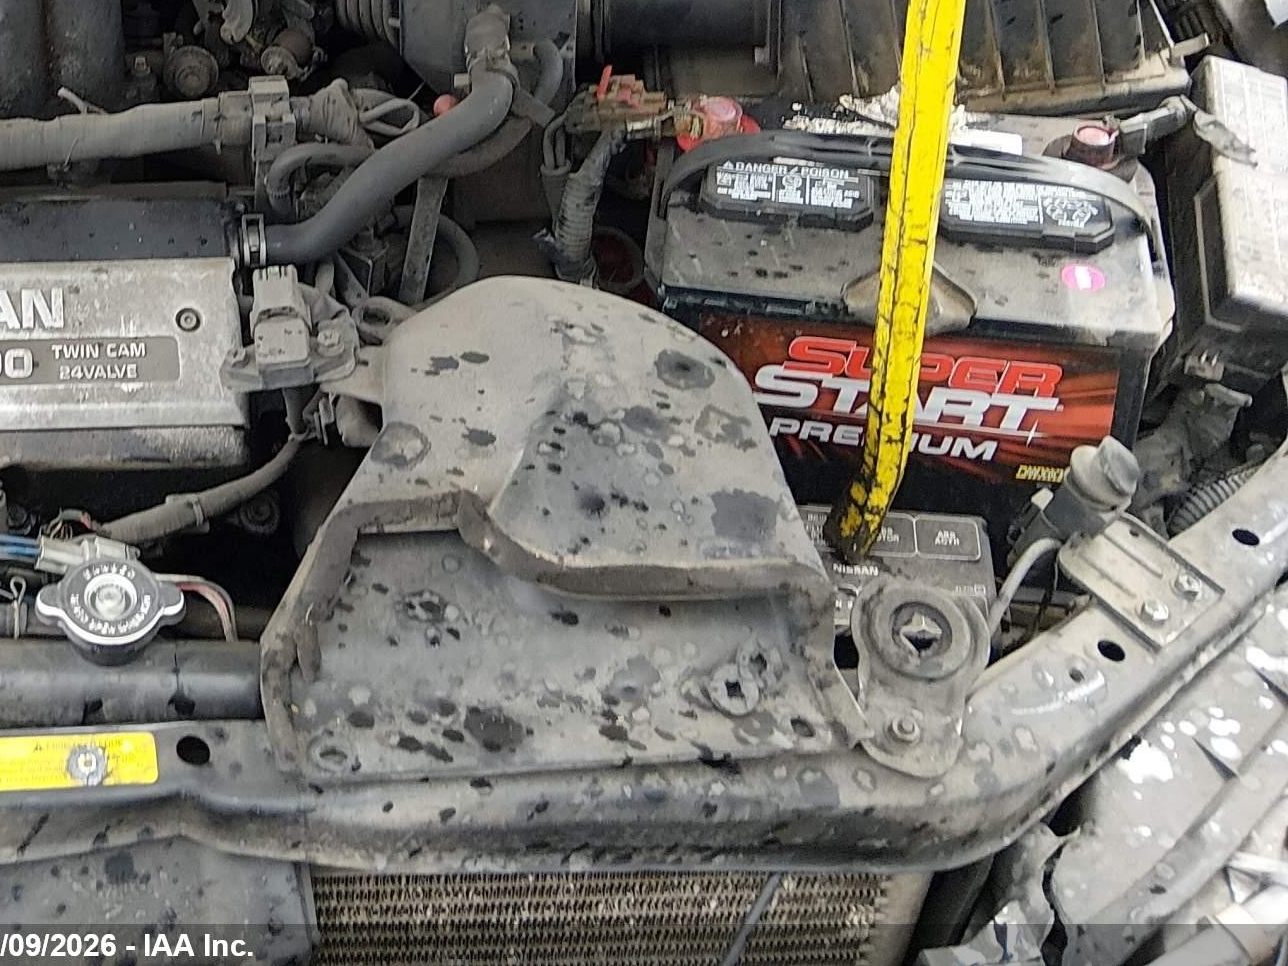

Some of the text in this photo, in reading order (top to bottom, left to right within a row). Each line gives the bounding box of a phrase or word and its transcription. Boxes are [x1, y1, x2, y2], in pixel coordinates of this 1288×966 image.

[735, 161, 788, 176] DANGER
[800, 166, 850, 180] POISON
[51, 342, 147, 361] TWIN CAM
[58, 362, 138, 381] 24VALVE
[769, 417, 999, 462] PREIUM
